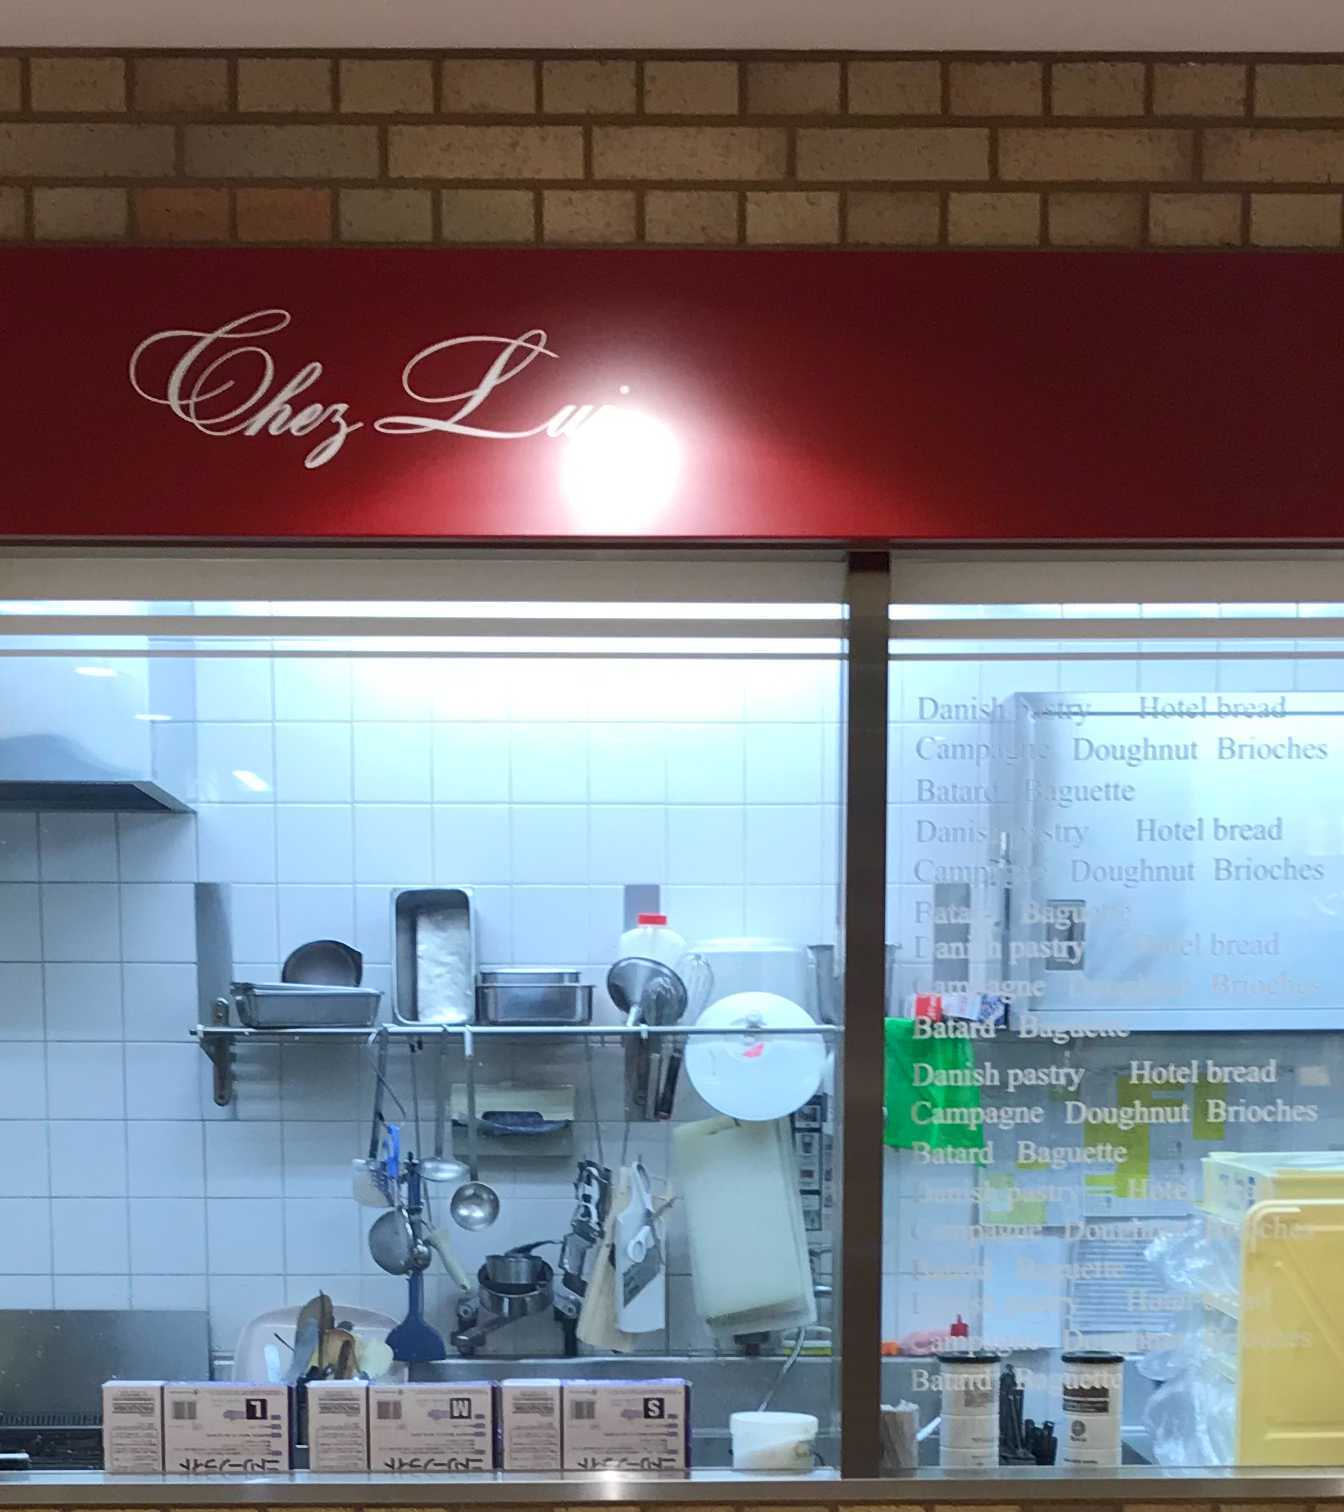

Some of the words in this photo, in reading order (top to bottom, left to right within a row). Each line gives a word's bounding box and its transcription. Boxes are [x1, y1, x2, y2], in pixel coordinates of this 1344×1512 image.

[129, 308, 363, 469] Chez
[374, 329, 631, 439] Lu
[917, 696, 1005, 720] Danish
[1139, 696, 1208, 719] Hotel
[1217, 696, 1288, 719] bread
[1073, 737, 1199, 767] Doughnut
[1217, 737, 1328, 760] Brioches
[1136, 818, 1204, 843] Hotel
[1213, 817, 1284, 842] bread
[1071, 858, 1196, 889] Doughnut
[1213, 857, 1325, 882] Brioches
[1009, 938, 1085, 965] pastry
[913, 1015, 996, 1039] Batard
[913, 1062, 1000, 1087] Danish
[1007, 1064, 1085, 1092] pastry
[1129, 1060, 1198, 1084] Hotel
[1206, 1059, 1278, 1083] bread
[912, 1101, 1044, 1130] Campagne
[1066, 1100, 1190, 1130] Doughnut
[1207, 1099, 1318, 1123] Brioches
[912, 1141, 994, 1165] Batard
[1017, 1140, 1128, 1170] Baguette
[248, 1399, 265, 1419] L
[450, 1399, 470, 1419] M
[645, 1399, 663, 1419] S
